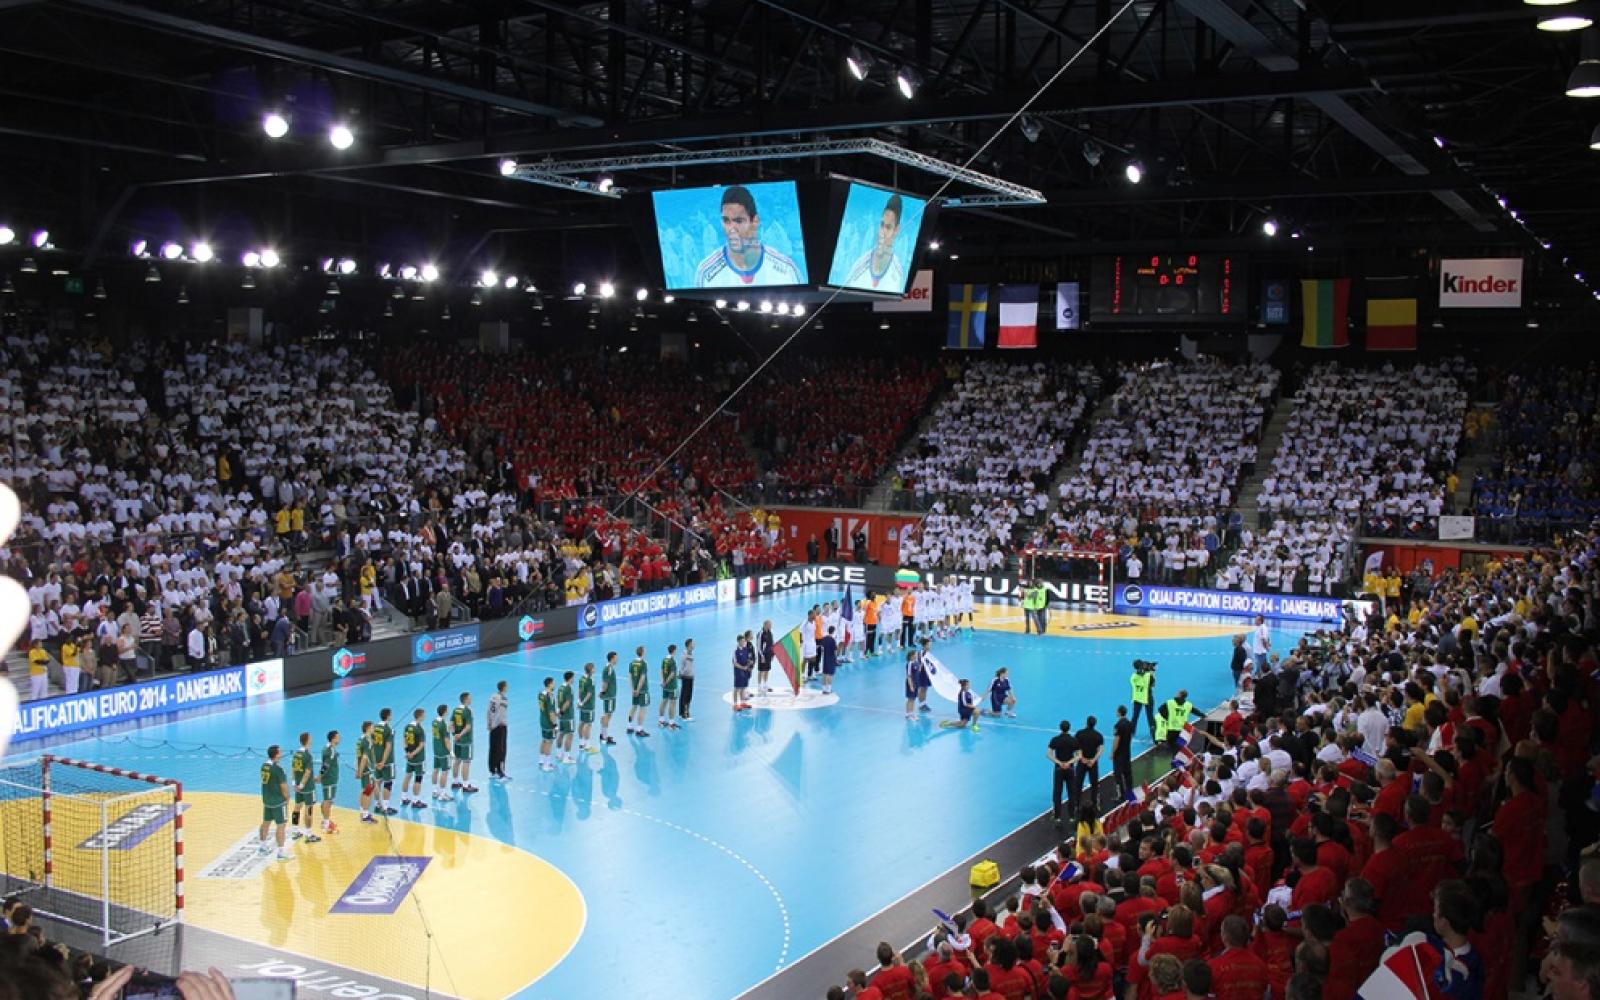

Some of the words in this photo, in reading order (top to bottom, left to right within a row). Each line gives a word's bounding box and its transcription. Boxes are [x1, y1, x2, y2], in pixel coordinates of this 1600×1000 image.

[758, 566, 866, 593] FRANCE
[601, 598, 648, 621] QUALIFICATION
[1150, 589, 1220, 608] QUALIFICATION
[1223, 594, 1250, 612] EURO
[1251, 596, 1273, 613] 2014
[1281, 600, 1338, 618] DANEMARK
[101, 690, 138, 718] EURO
[140, 684, 167, 711] 2014
[176, 671, 242, 704] DANEMARK
[1175, 708, 1185, 716] TV
